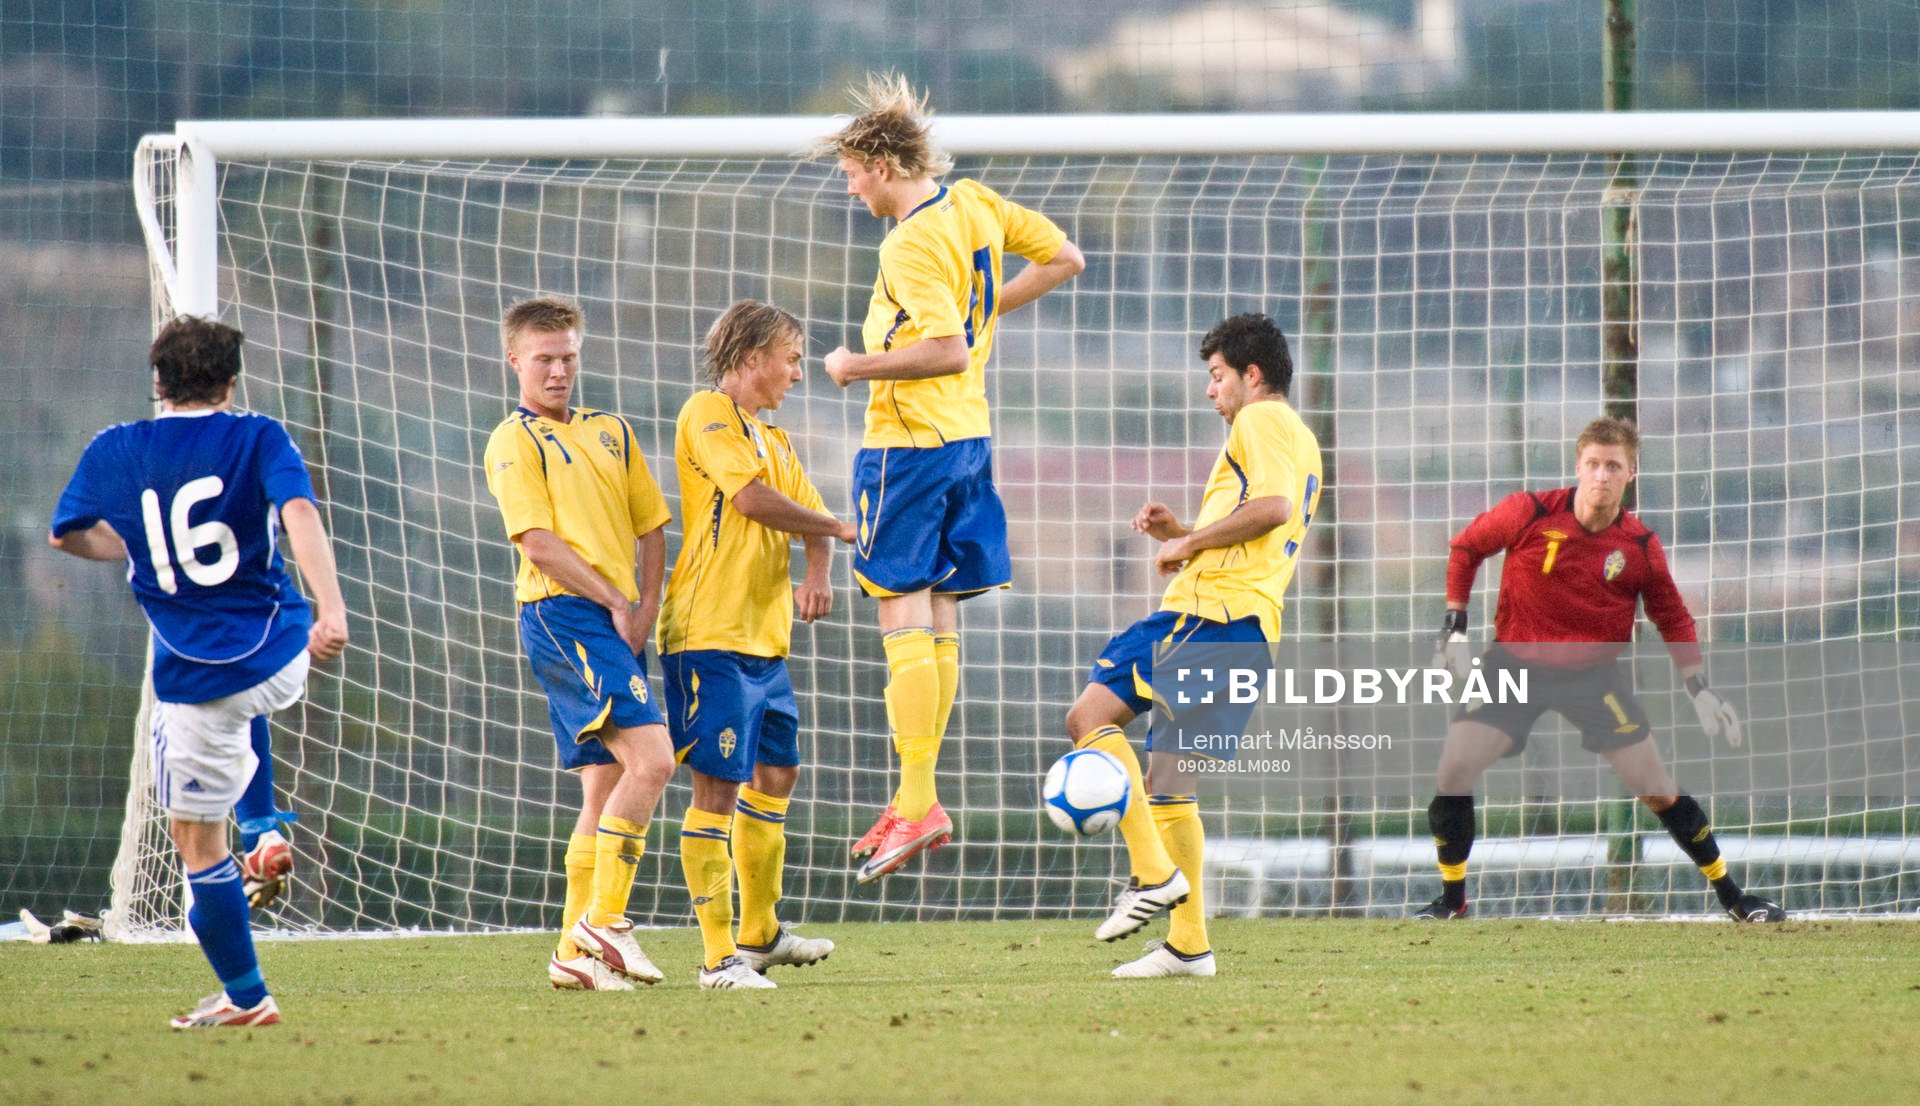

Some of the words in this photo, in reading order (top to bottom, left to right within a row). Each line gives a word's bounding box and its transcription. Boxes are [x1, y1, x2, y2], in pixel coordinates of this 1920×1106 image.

[141, 475, 239, 595] 16
[1542, 541, 1559, 574] 1
[1603, 694, 1628, 725] 1
